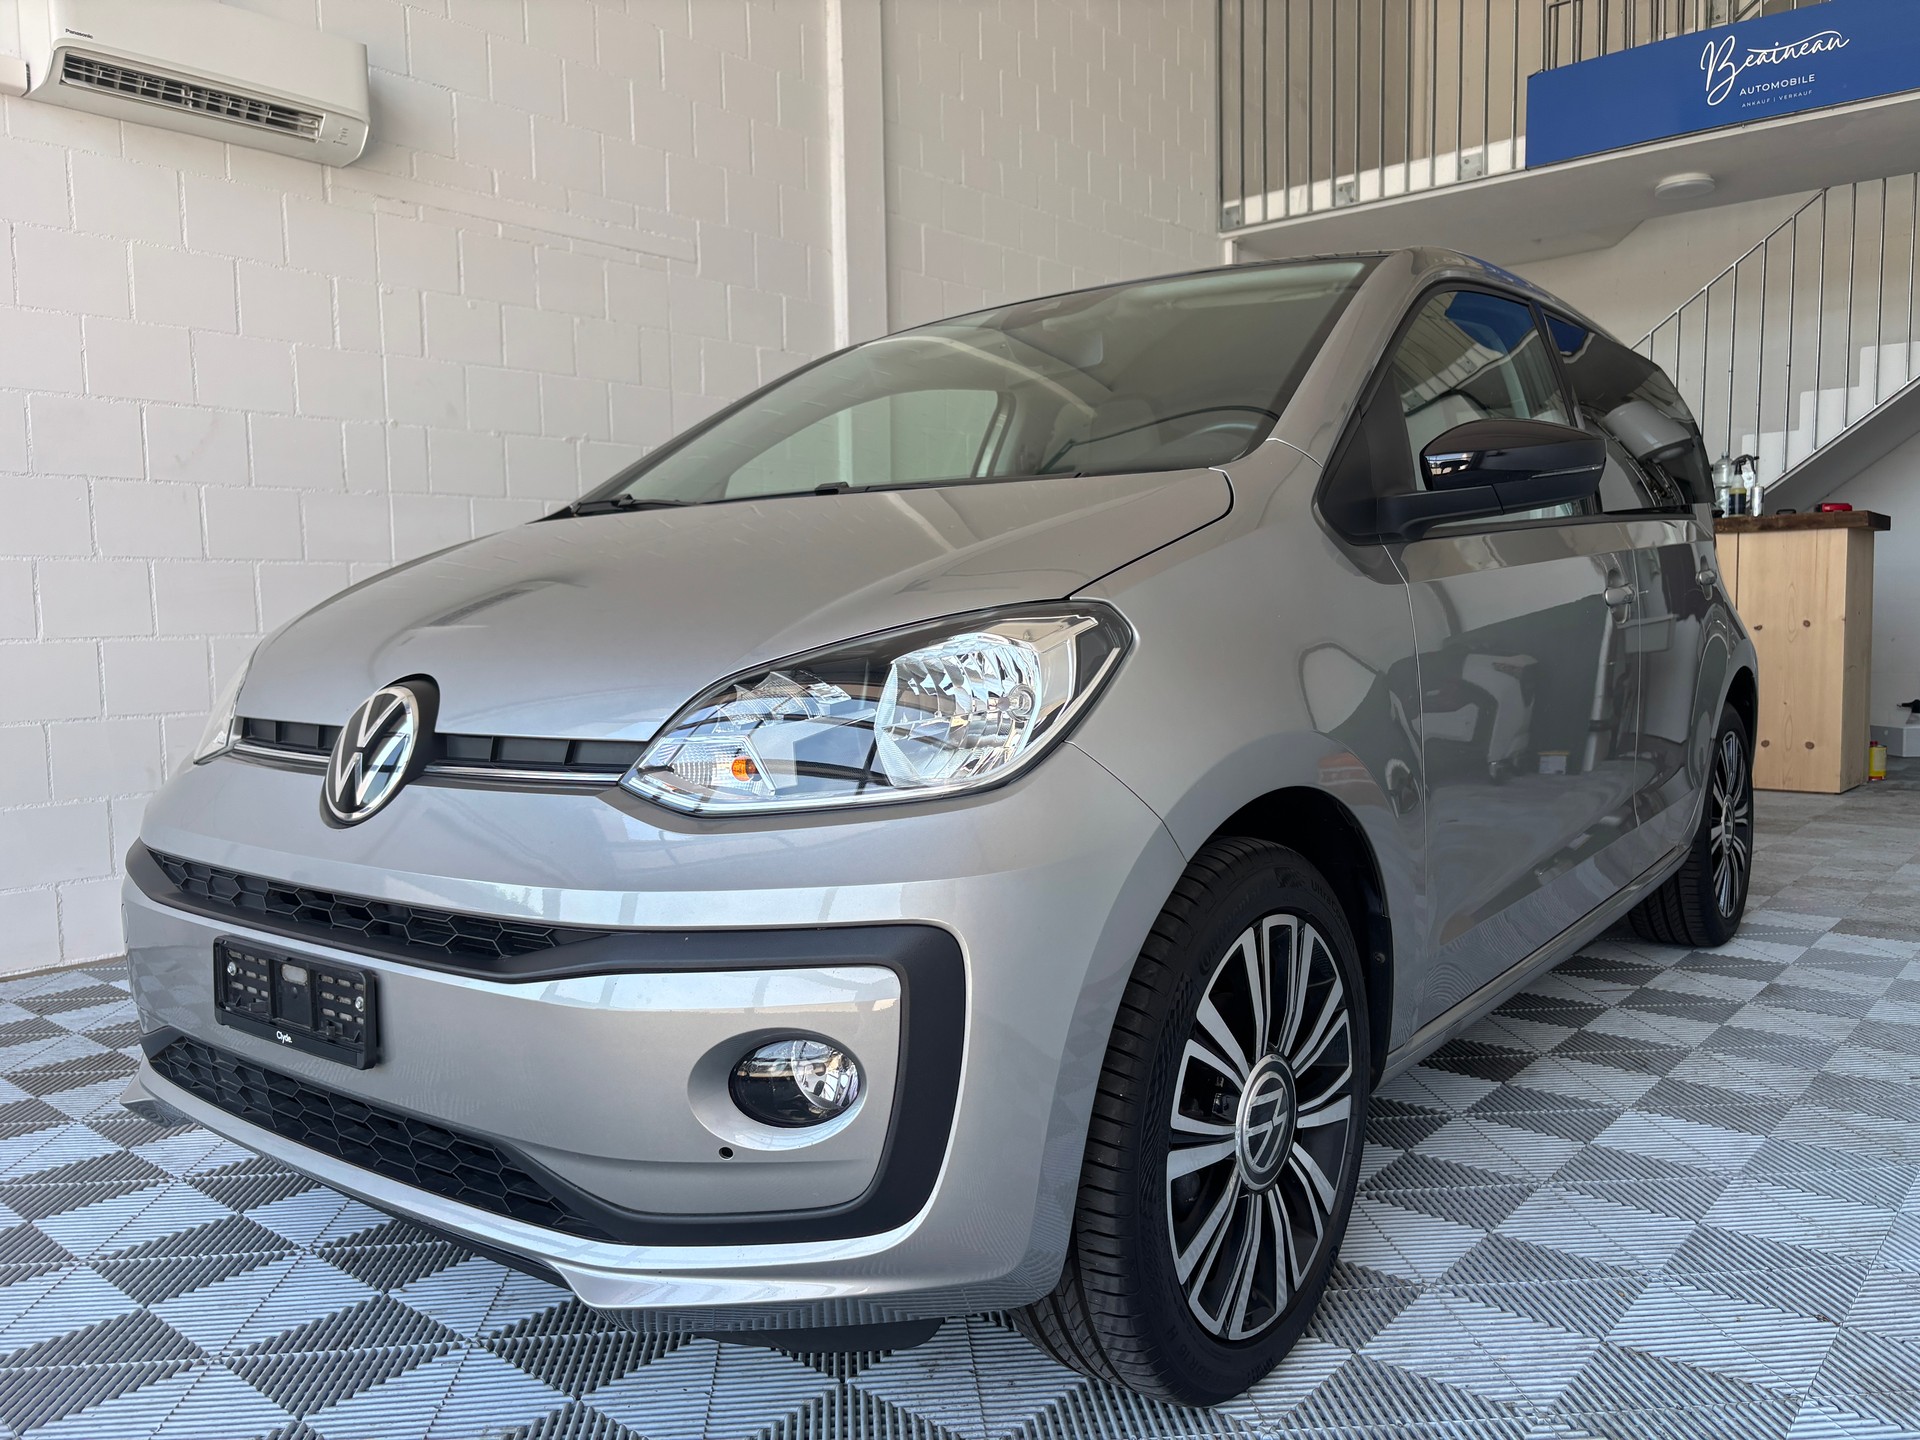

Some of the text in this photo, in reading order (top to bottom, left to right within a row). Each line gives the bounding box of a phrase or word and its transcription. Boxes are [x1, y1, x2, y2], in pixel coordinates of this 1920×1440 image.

[65, 28, 93, 39] Panasonic
[1739, 73, 1816, 96] AUTOMOBILE
[1741, 89, 1813, 108] ANKAUF VERKAUF
[327, 687, 419, 819] VW
